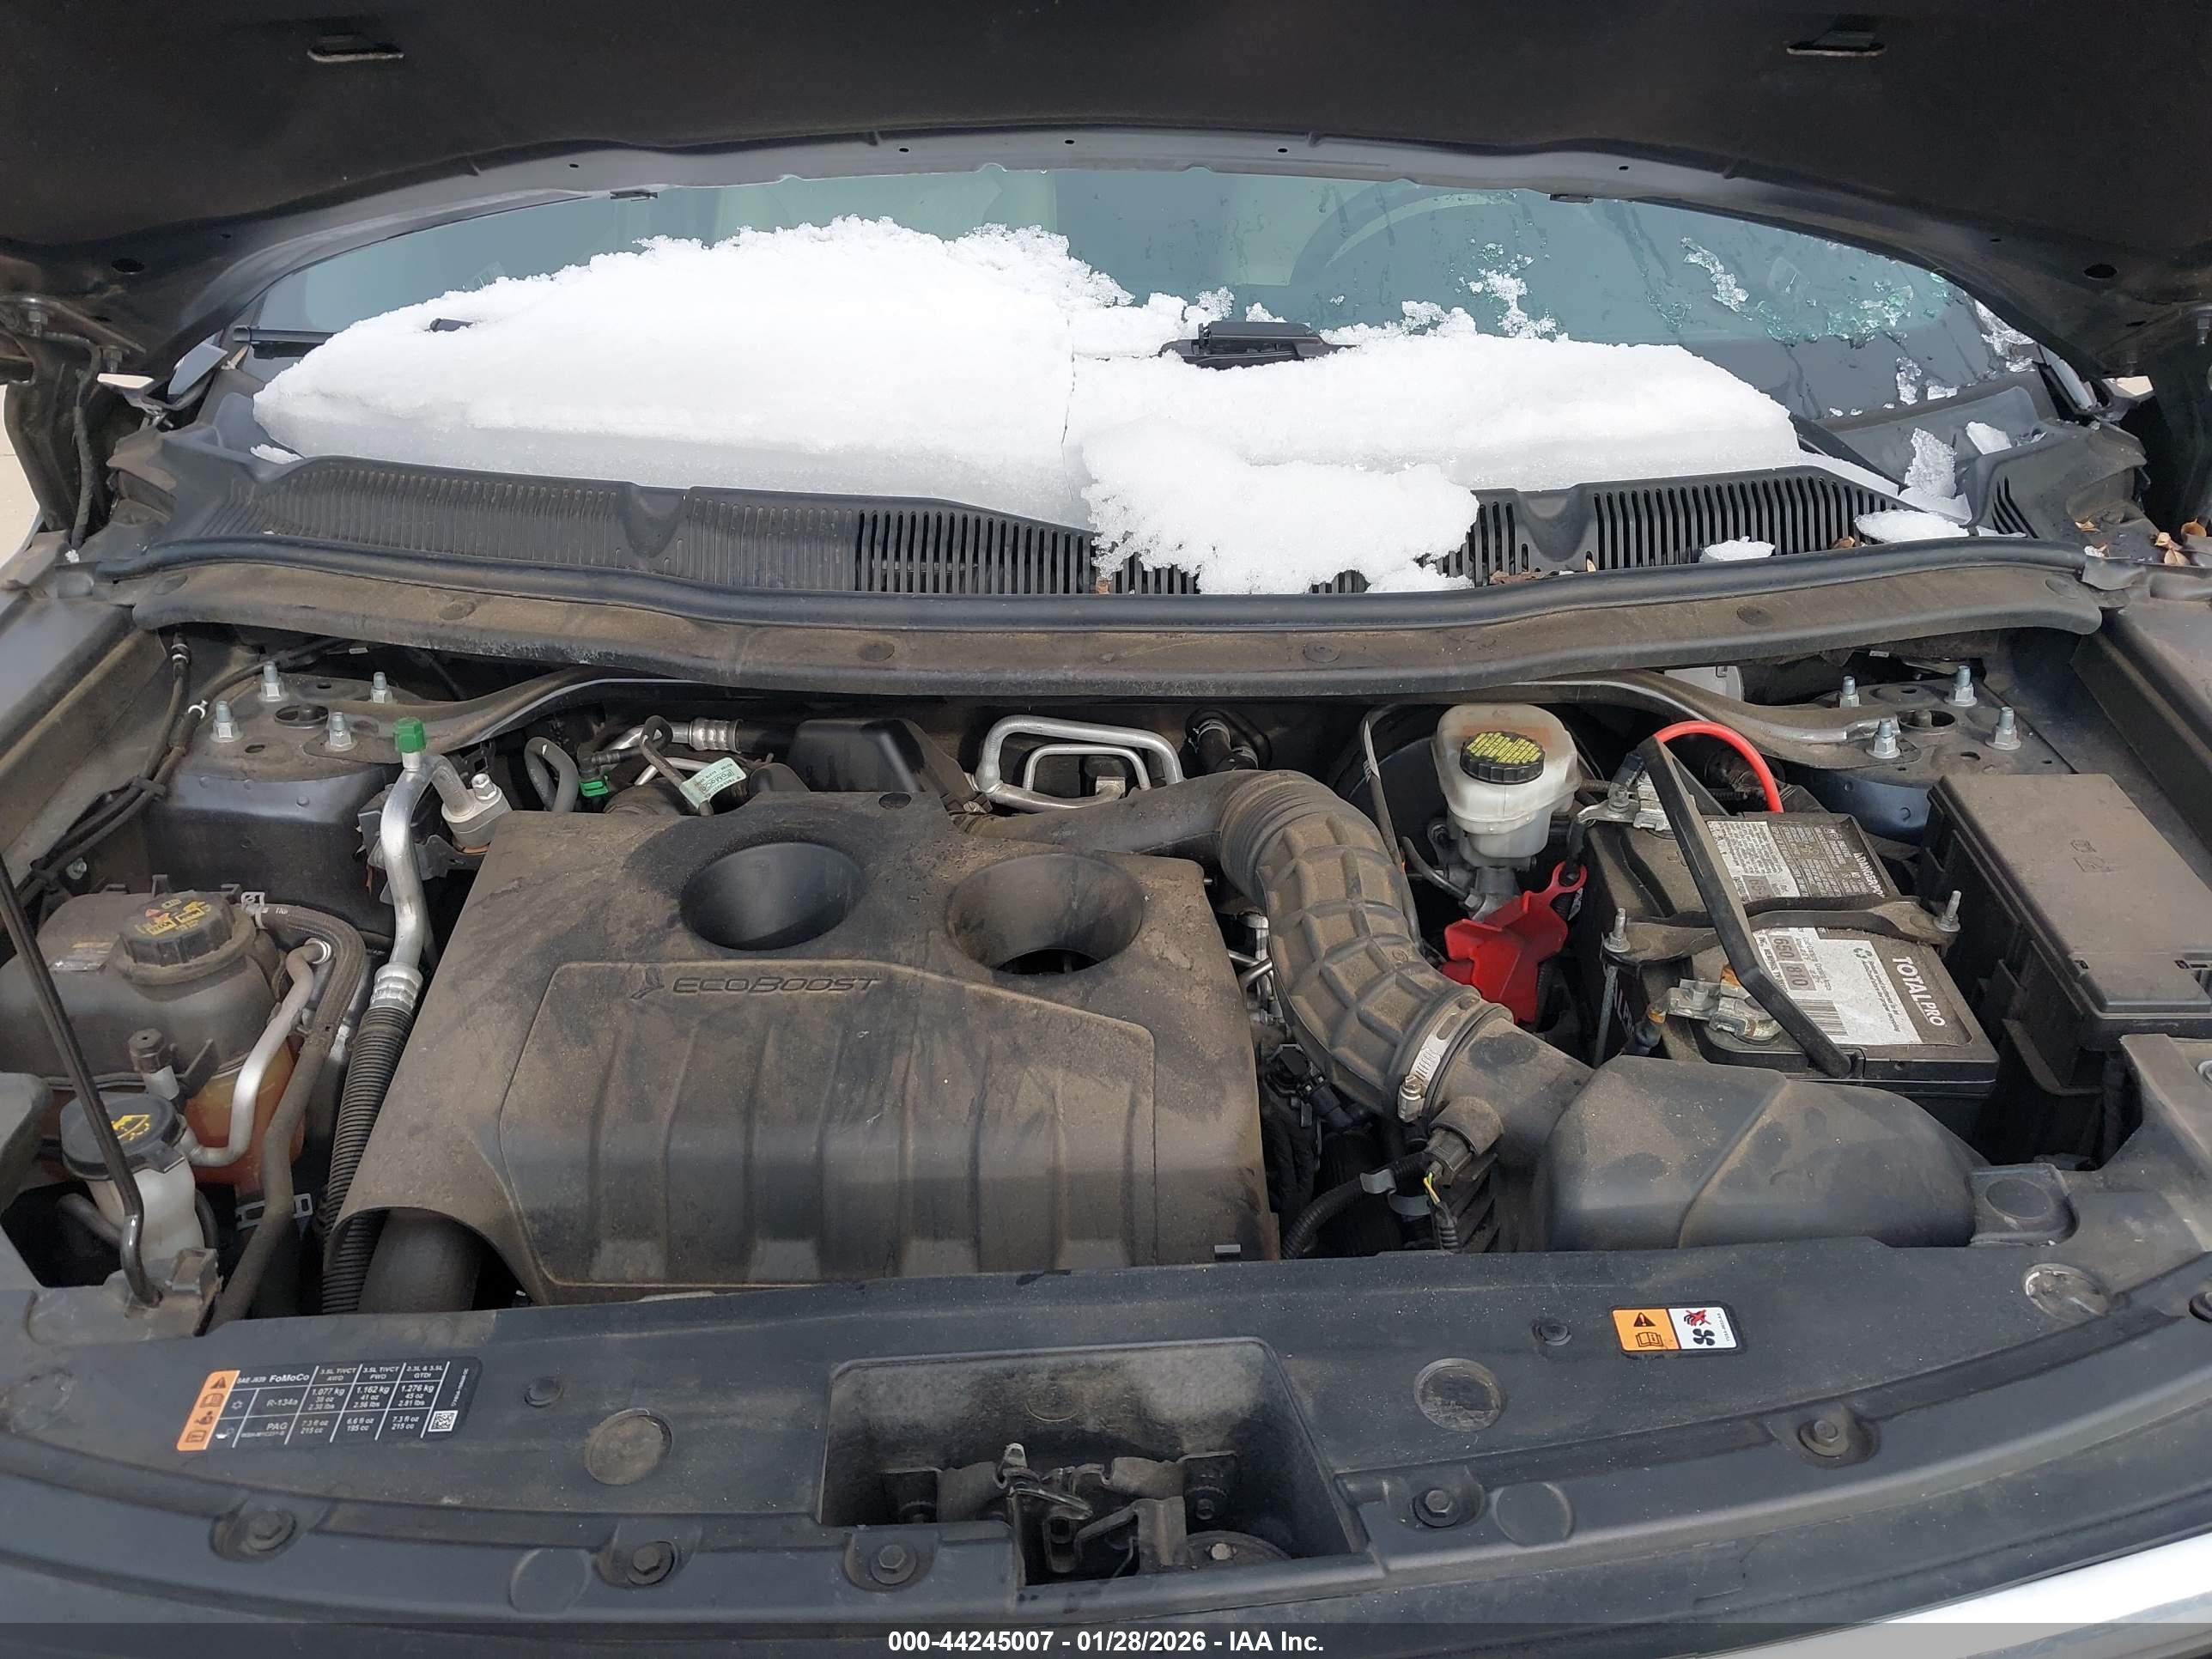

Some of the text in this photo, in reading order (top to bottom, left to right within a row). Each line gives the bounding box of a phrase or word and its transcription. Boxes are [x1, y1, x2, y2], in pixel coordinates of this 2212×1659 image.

[1786, 966, 1808, 986] 810
[269, 1373, 310, 1383] FoMoCo
[312, 1387, 345, 1396] 1.077 kg
[357, 1386, 390, 1395] 1.162 kg
[401, 1384, 434, 1393] 1.276 kg
[267, 1398, 298, 1407] R-134a
[266, 1422, 289, 1431] PAG
